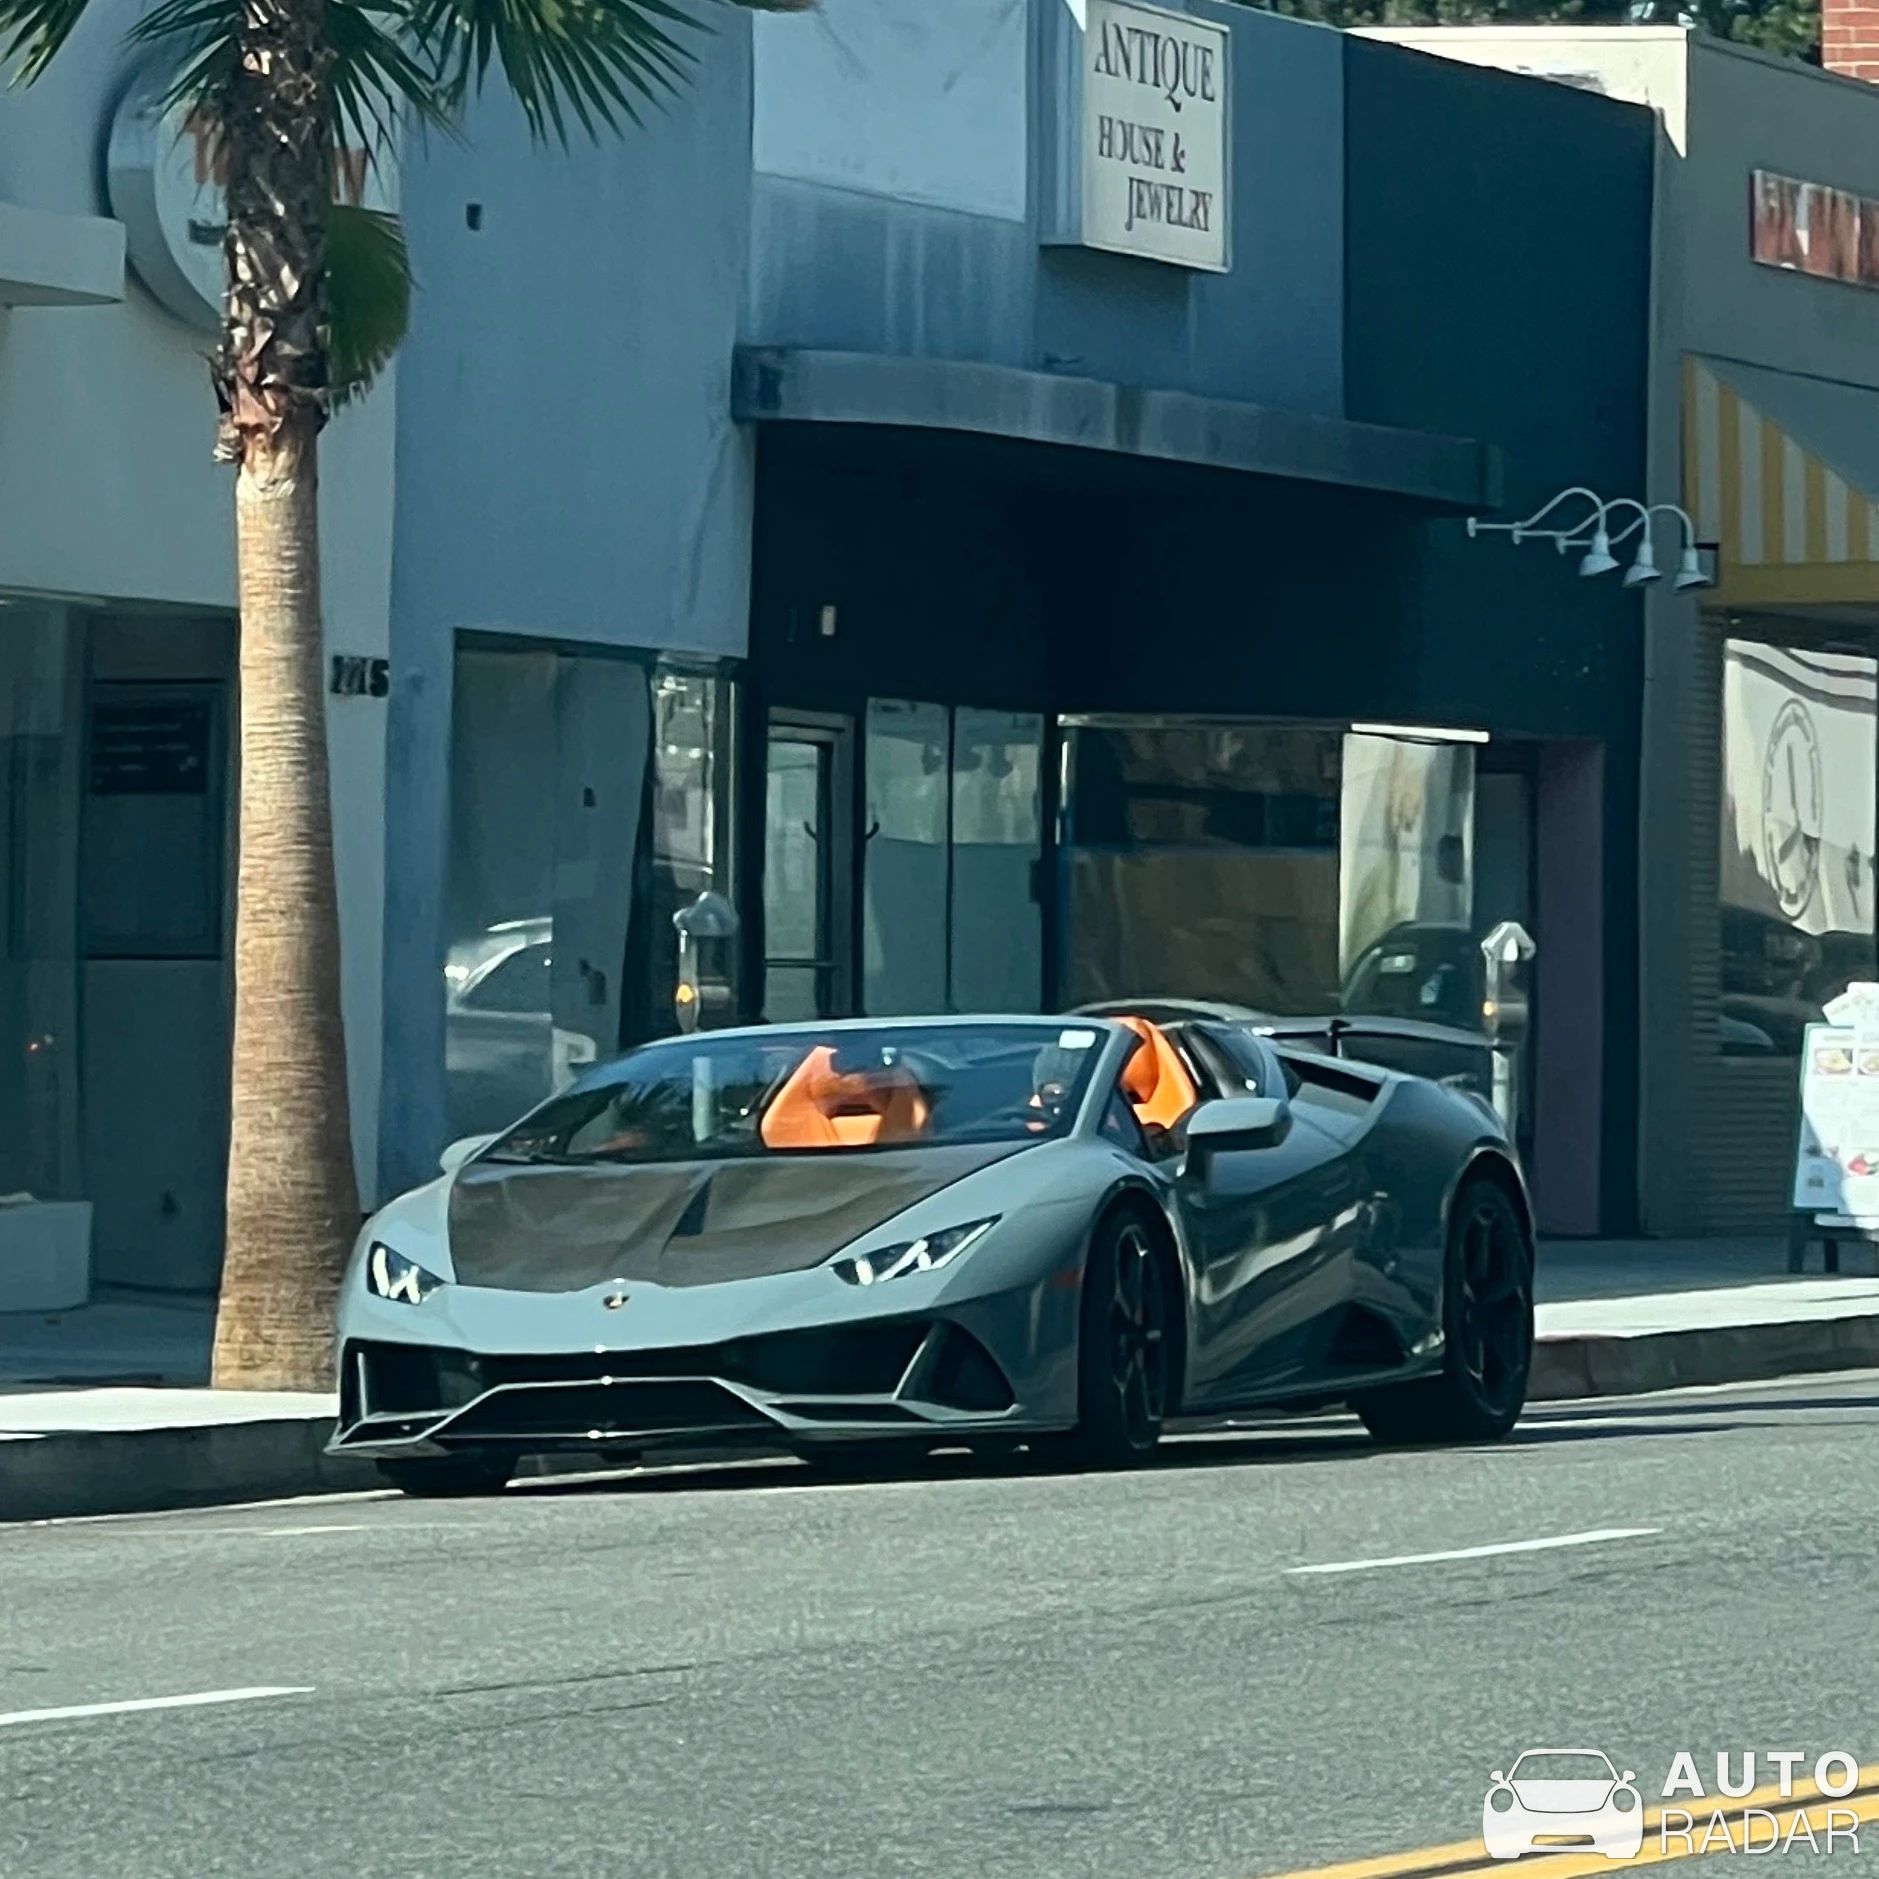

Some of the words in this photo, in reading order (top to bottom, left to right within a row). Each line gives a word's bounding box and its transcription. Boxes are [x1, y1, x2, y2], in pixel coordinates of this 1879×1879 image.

[1094, 20, 1215, 112] ANTIQUE
[1098, 115, 1165, 170] HOUSE
[1170, 132, 1186, 173] &
[1124, 176, 1213, 232] JEWELRY
